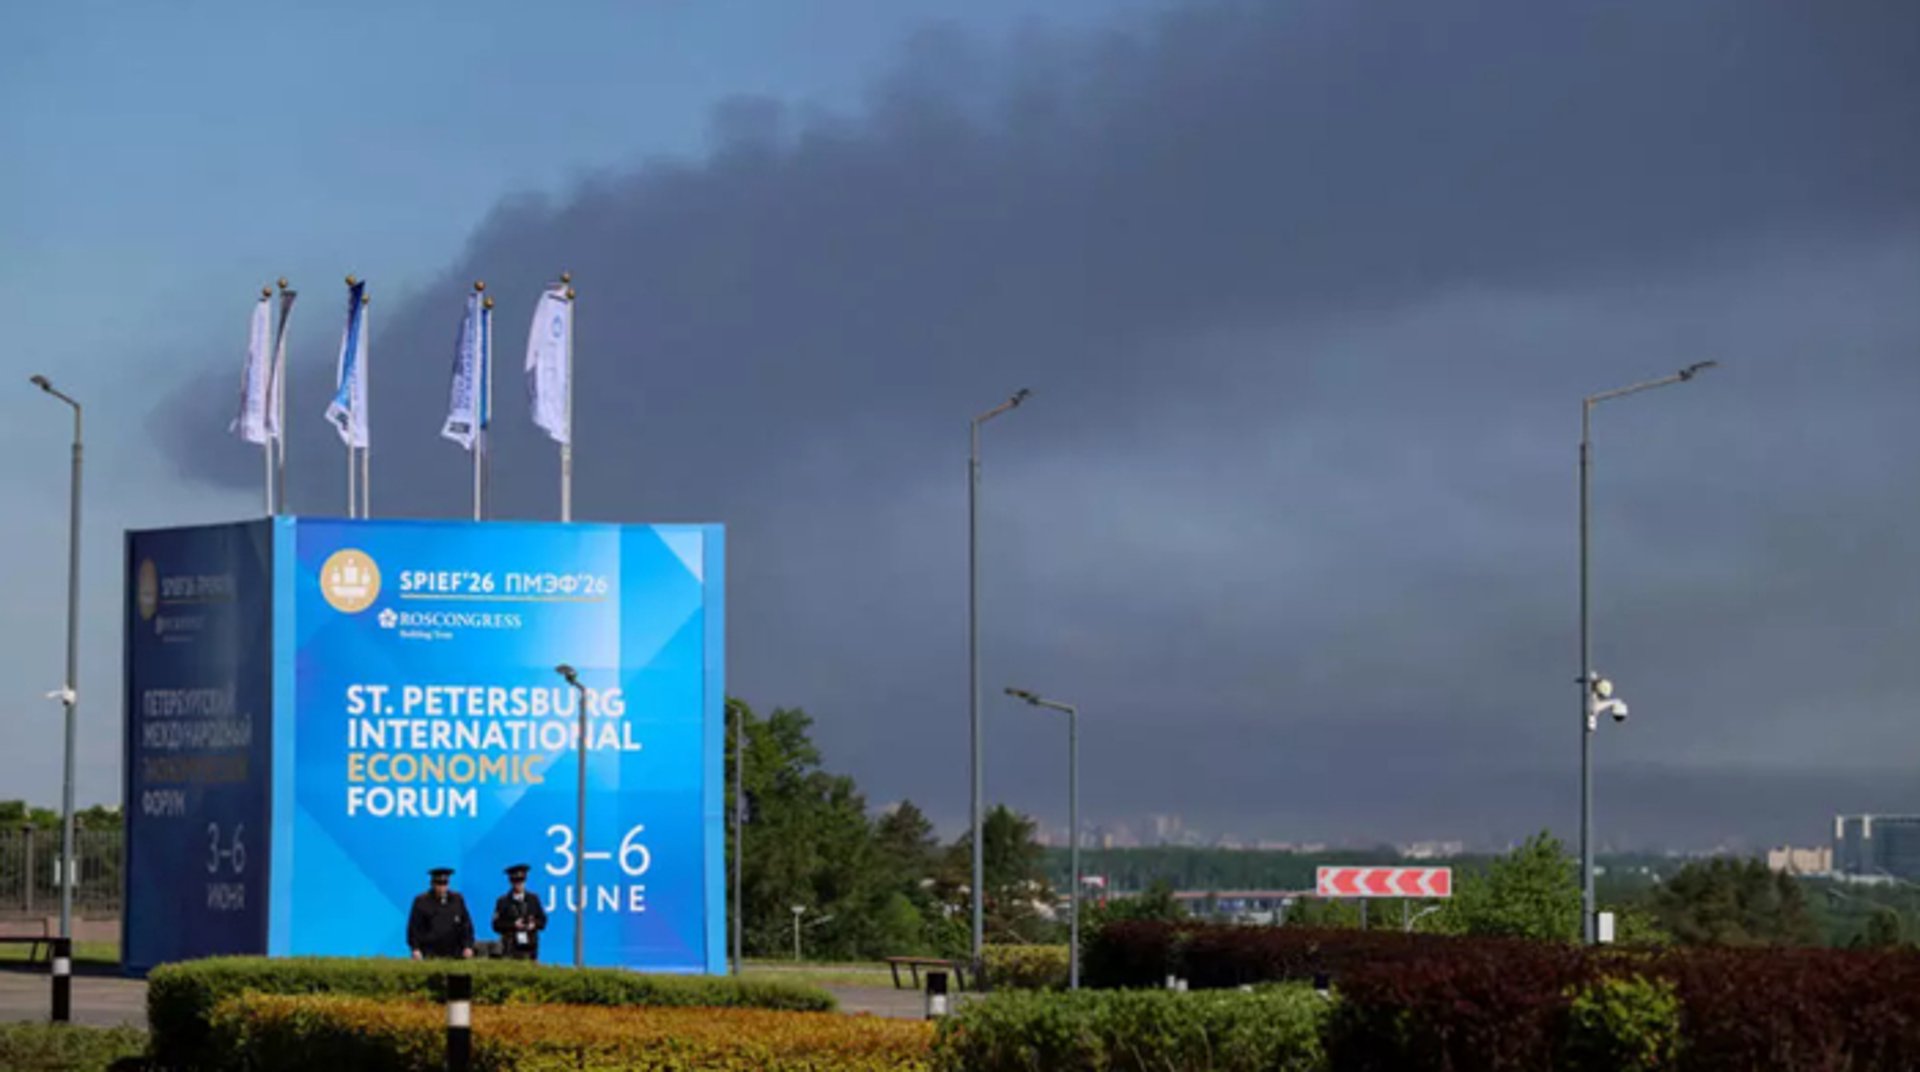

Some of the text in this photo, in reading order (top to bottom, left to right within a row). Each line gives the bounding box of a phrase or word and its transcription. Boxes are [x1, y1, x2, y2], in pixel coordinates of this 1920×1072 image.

[400, 571, 608, 594] SPIEF'26 ПМЭФ'26
[400, 611, 522, 629] ROSCONGRESS
[346, 684, 625, 717] ST. PETERSBURG
[347, 719, 642, 750] INTERNATIONAL
[347, 753, 544, 784] ECONOMIC
[347, 786, 478, 818] FORUM
[545, 885, 646, 912] JUNE
